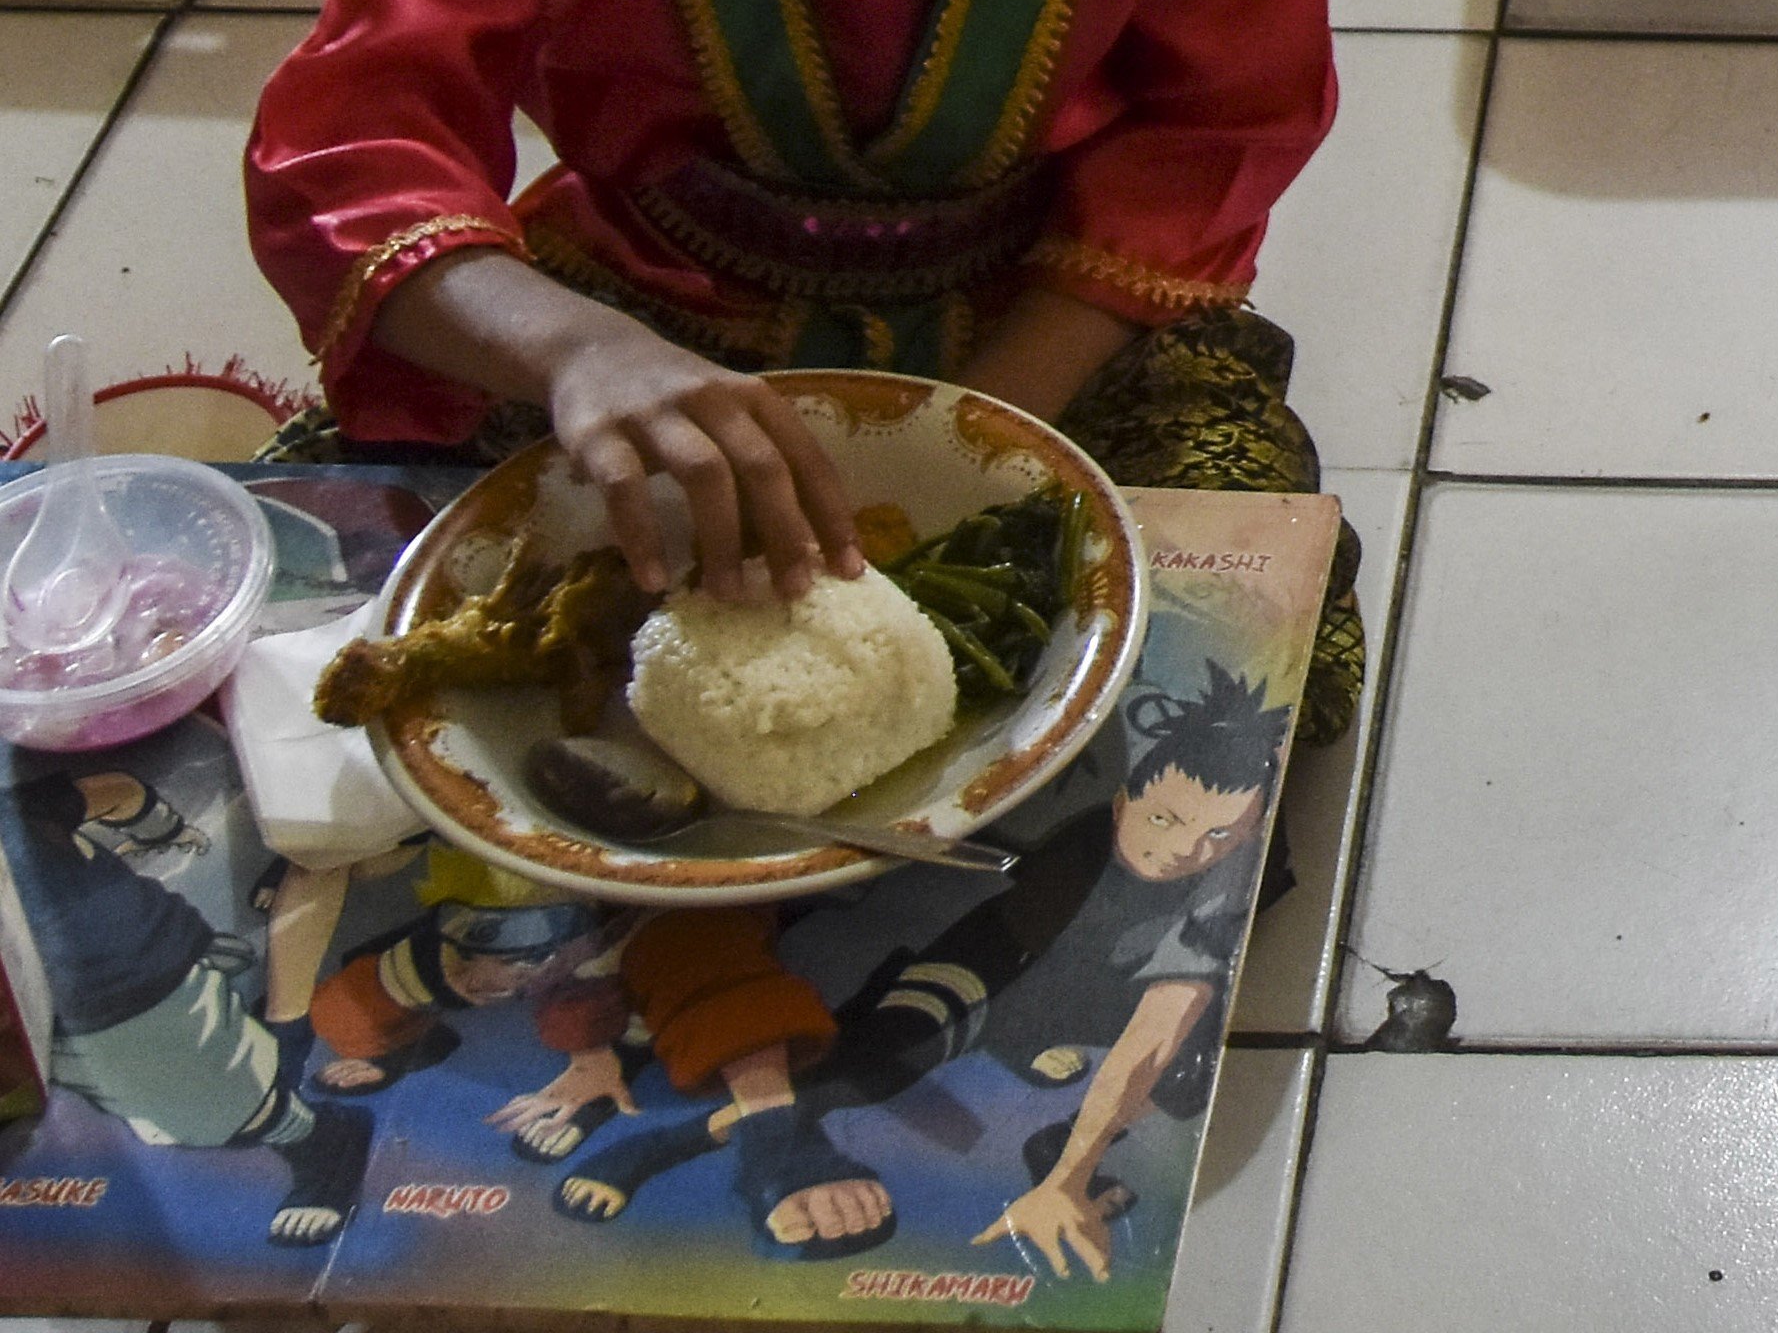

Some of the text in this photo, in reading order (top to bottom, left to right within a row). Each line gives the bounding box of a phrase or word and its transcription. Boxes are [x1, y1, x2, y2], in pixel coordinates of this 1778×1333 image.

[1151, 551, 1271, 573] KAKASHI
[0, 1176, 107, 1209] ASUKE
[384, 1183, 510, 1219] NARUTO
[842, 1270, 1035, 1307] SHIKAMARU
